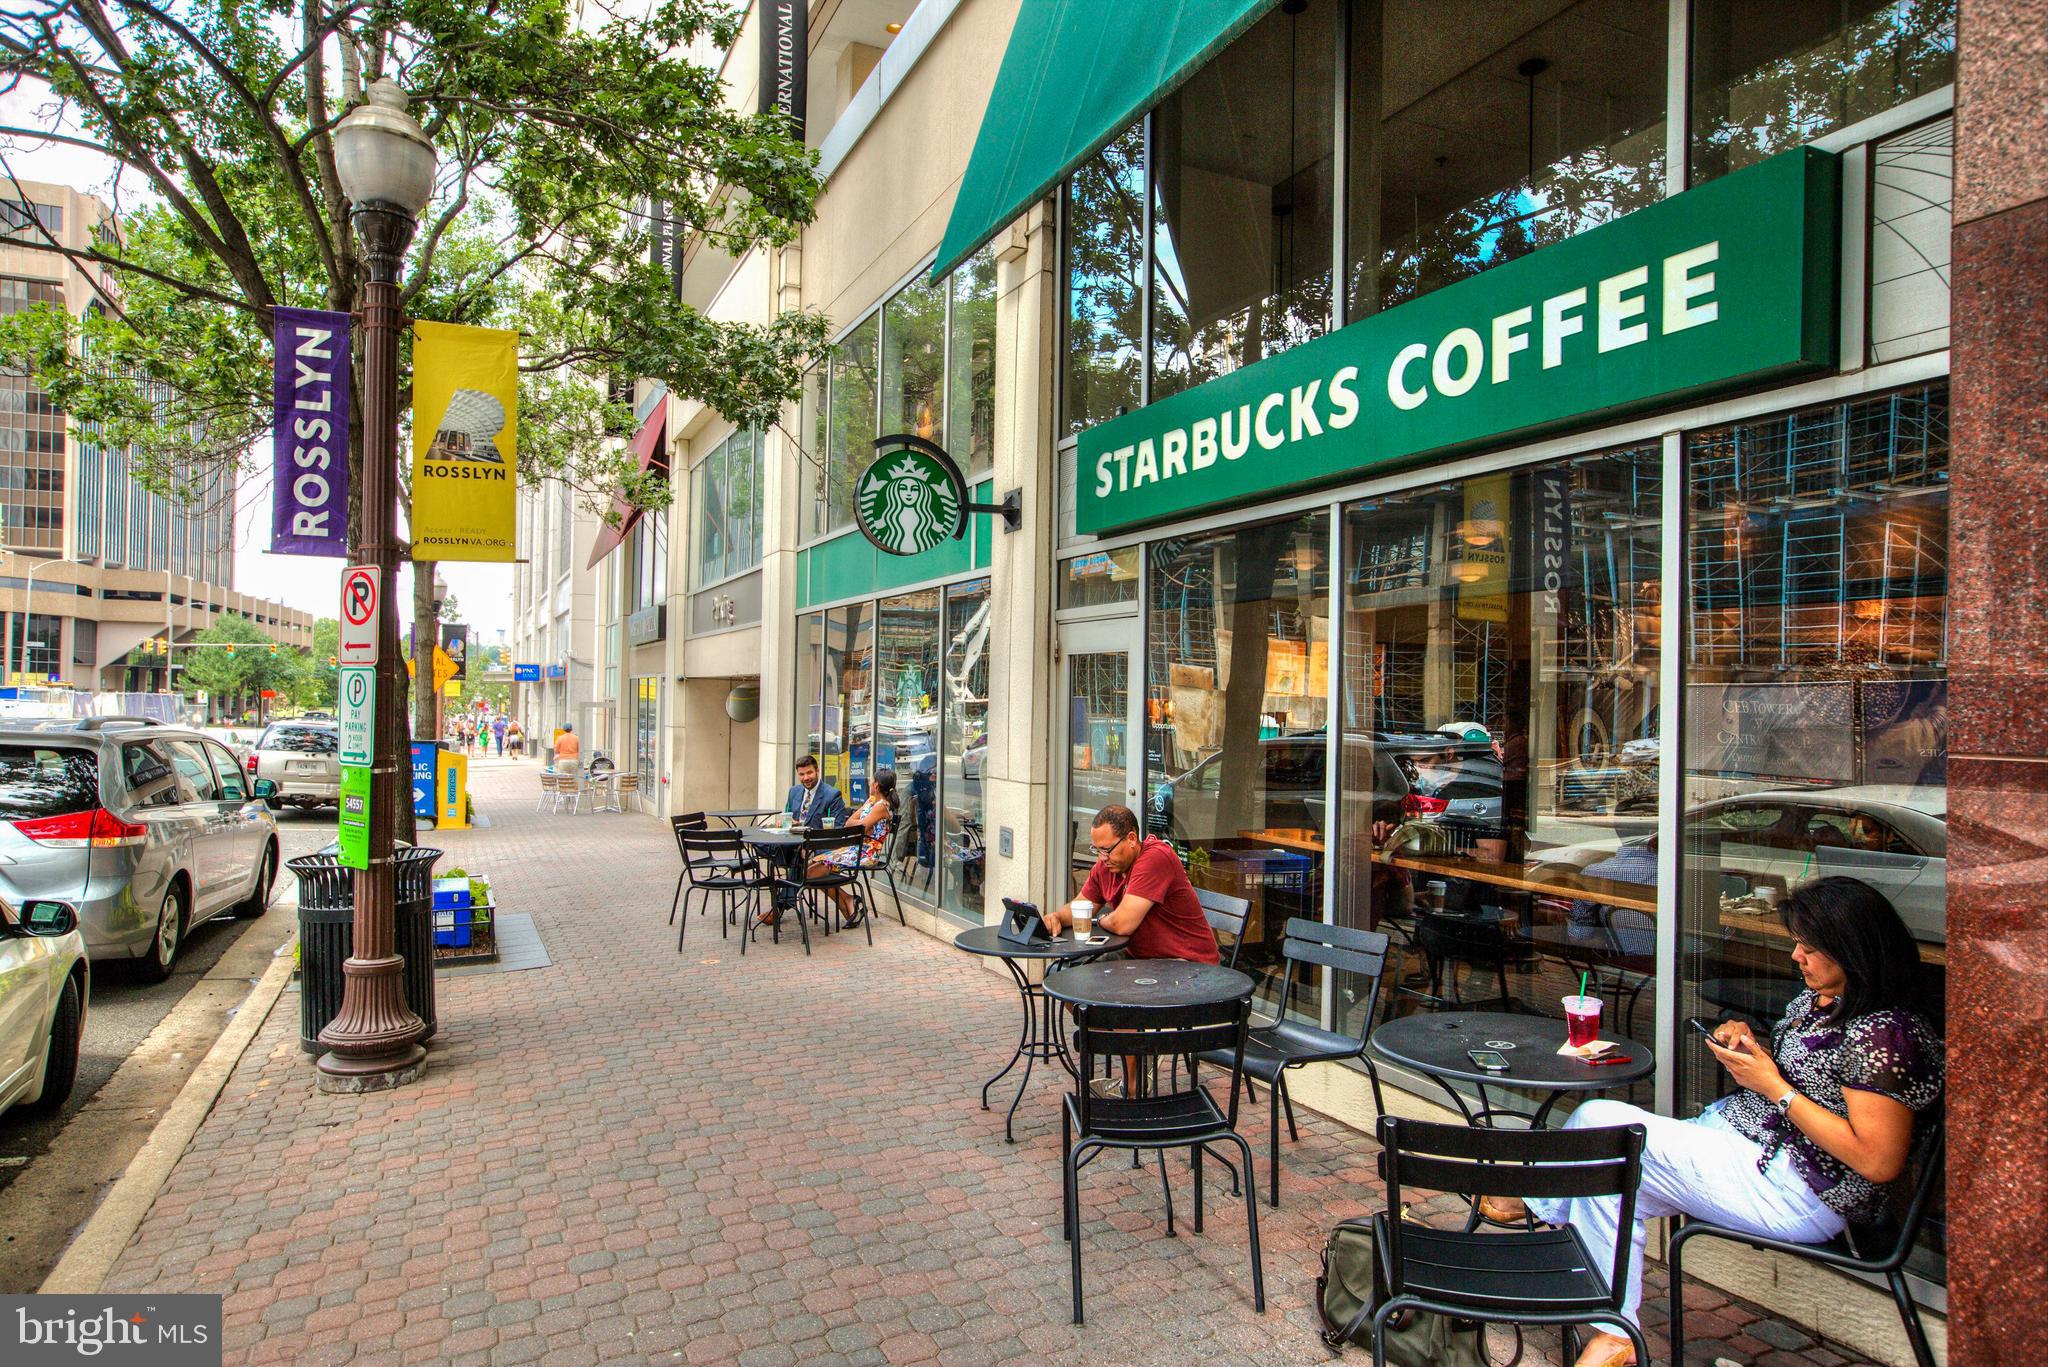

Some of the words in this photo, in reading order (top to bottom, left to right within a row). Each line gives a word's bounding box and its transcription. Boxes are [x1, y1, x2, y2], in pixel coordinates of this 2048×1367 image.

[777, 3, 792, 117] ERNATIONAL
[1095, 365, 1360, 498] STARBUCKS
[1387, 240, 1720, 411] COFFEE
[292, 327, 333, 537] ROSSLYN
[423, 465, 506, 480] ROSSLYN
[436, 657, 446, 666] AL
[353, 679, 362, 703] P
[351, 709, 361, 719] PAY
[345, 721, 367, 732] PARKING
[413, 763, 428, 771] LIC
[449, 768, 457, 804] express
